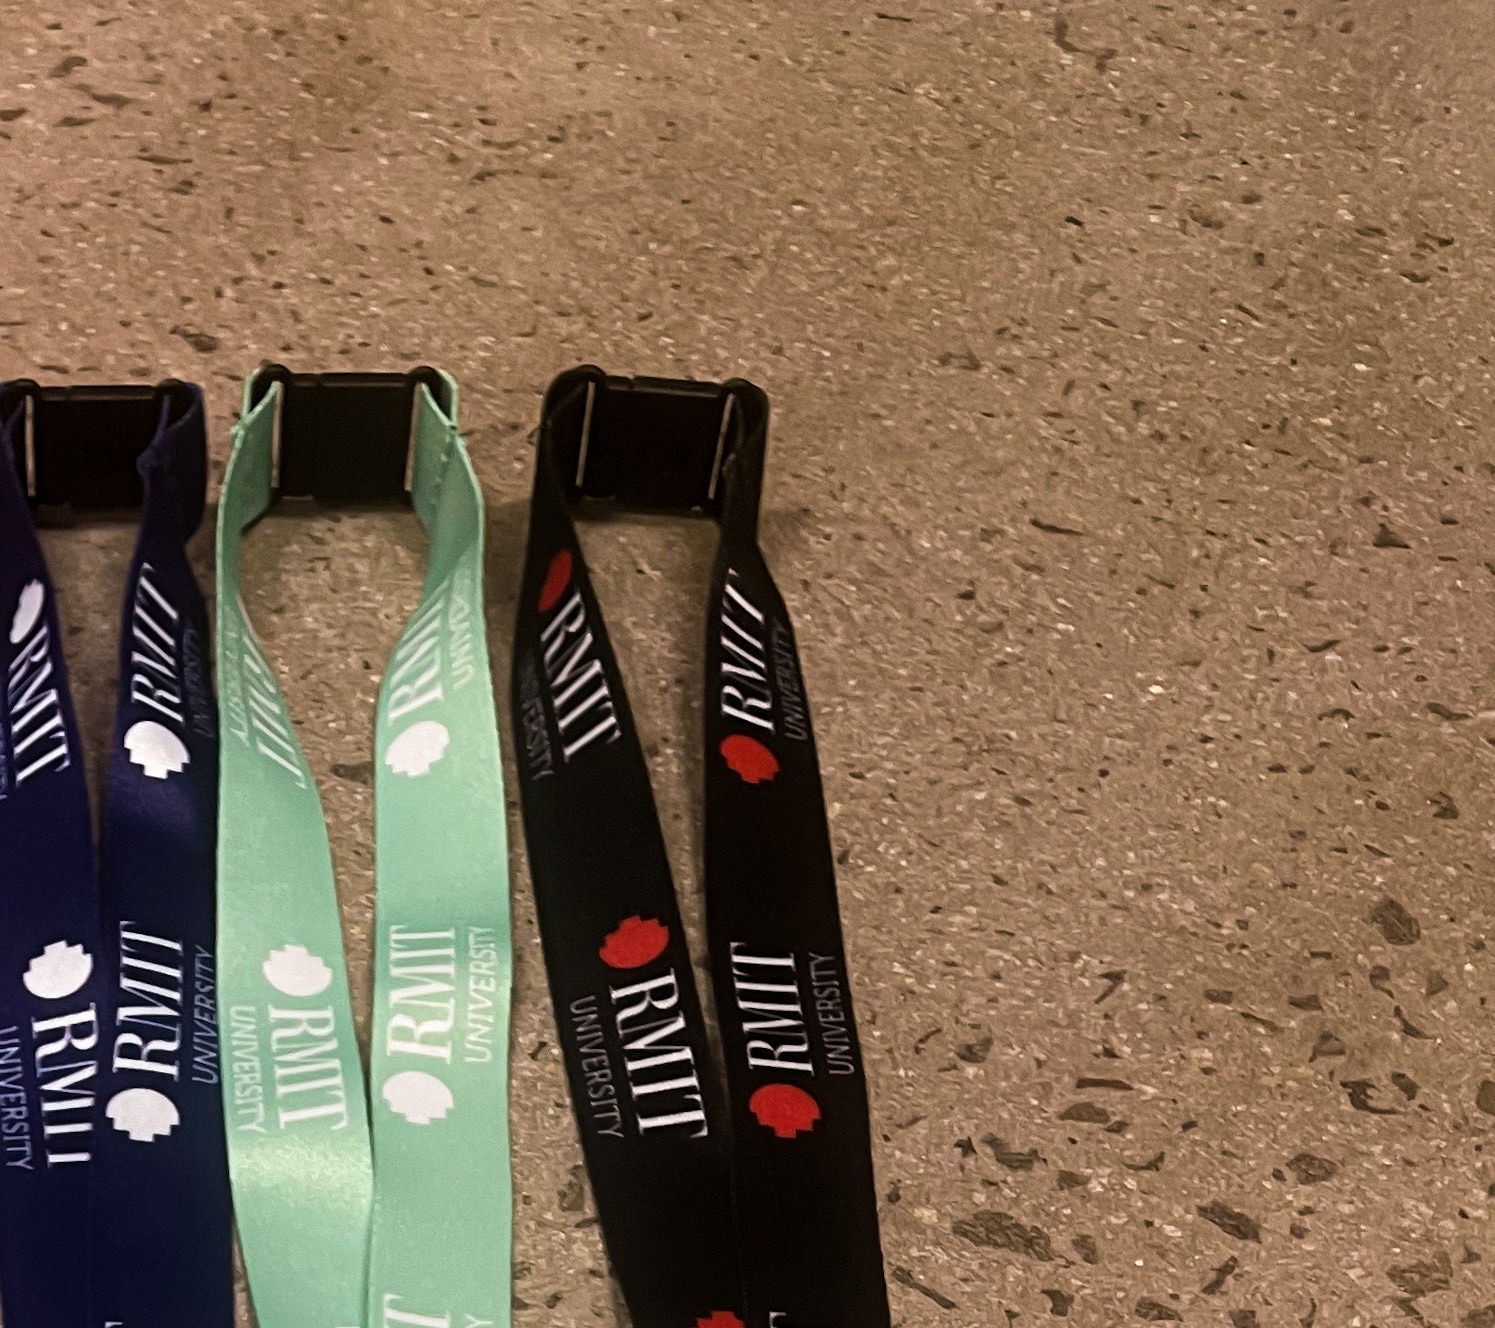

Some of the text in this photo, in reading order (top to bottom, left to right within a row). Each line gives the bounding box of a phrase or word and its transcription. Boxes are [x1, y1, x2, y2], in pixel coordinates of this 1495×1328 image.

[7, 622, 72, 787] RMIT
[131, 561, 187, 728] RMIT
[540, 585, 622, 764] RMIT
[721, 567, 776, 734] RMIT
[112, 920, 184, 1083] RMIT
[191, 944, 216, 1085] UNIVERSITY
[386, 924, 456, 1064] RMIT
[465, 926, 499, 1063] UNIVERSITY
[610, 967, 708, 1139] RMIT
[729, 940, 815, 1077] RMIT
[808, 952, 856, 1077] UNIVERSITY
[228, 1005, 267, 1134] UNIVERSITY
[268, 1003, 349, 1131] RMIT
[570, 994, 625, 1139] UNIVERSITY
